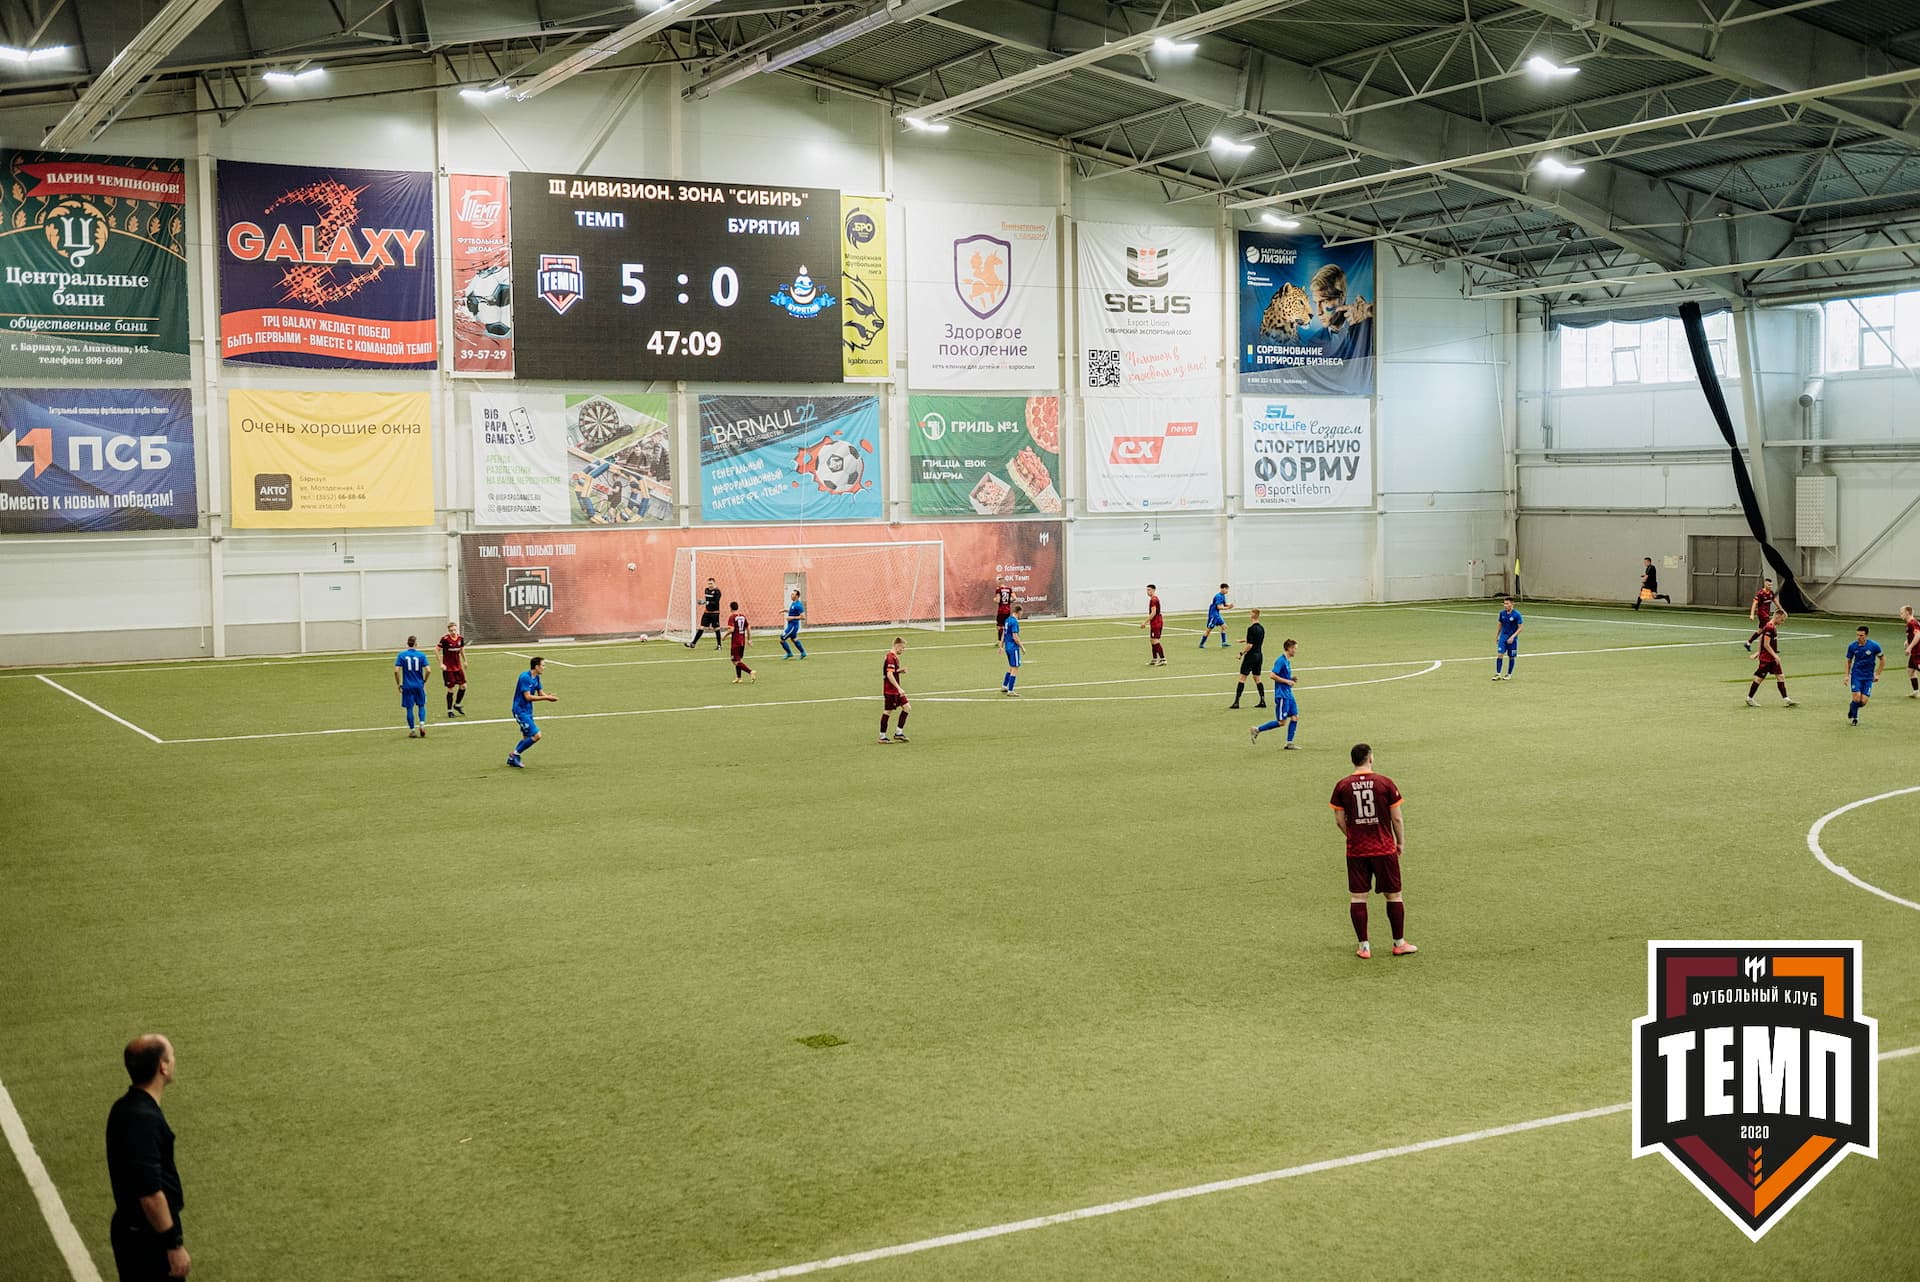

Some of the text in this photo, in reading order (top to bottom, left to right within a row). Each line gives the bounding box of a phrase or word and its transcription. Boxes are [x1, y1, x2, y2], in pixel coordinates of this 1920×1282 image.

[46, 172, 180, 194] ПАРИМ ЧЕМПИОНОВ!
[570, 180, 674, 200] ДИВИЗИОН.
[678, 186, 725, 203] ЗОНА
[729, 189, 809, 207] "СИБИРЬ"
[574, 210, 624, 228] ТЕМП
[727, 217, 801, 236] БУРЯТИЯ
[227, 221, 425, 267] GALAXY
[1260, 255, 1297, 264] ЛИЗИНГ
[6, 266, 149, 290] Центральные
[542, 271, 579, 293] ТЕМП
[621, 263, 646, 305] 5
[711, 265, 740, 307] 0
[52, 288, 105, 307] бани
[1105, 294, 1191, 313] SEUS
[9, 318, 148, 332] общественные бани
[262, 315, 391, 339] ТРЦ GALAXY ЖЕЛАЕТ ПОБЕД!
[1128, 318, 1170, 327] Export Union
[945, 323, 1022, 341] Здоровое
[20, 342, 64, 354] Барнаул,
[66, 344, 80, 353] ул.
[227, 333, 253, 348] БЫТЬ
[255, 333, 301, 345] ПЕРВЫМИ
[309, 335, 345, 350] ВМЕСТЕ
[346, 338, 353, 350] С
[354, 341, 404, 355] КОМАНДОЙ
[646, 331, 722, 357] 47:09
[939, 343, 1028, 357] поколение
[1257, 345, 1323, 355] СОРЕВНОВАНИЕ
[39, 355, 84, 366] телефон:
[460, 350, 507, 360] 39-57-29
[1265, 356, 1305, 366] ПРИРОДЕ
[1306, 357, 1344, 366] БИЗНЕСА
[484, 409, 499, 419] BIG
[241, 418, 421, 437] Очень хорошие окна
[485, 421, 507, 432] PAPA
[951, 421, 1019, 432] ГРИЛЬ №1
[1171, 425, 1193, 433] news
[1254, 420, 1306, 432] SportLife
[1310, 420, 1364, 439] Создаем
[485, 433, 515, 445] GAMES
[1255, 440, 1360, 453] СПОРТИВНУЮ
[69, 435, 172, 471] ПСБ
[712, 458, 764, 480] ГЕНЕРАЛЬНЫЙ
[923, 472, 963, 480] ШАУРМА
[1255, 456, 1360, 481] ФОРМУ
[712, 468, 783, 496] ИНФОРМАЦИОННЫЙ
[260, 486, 287, 495] АКТО
[1268, 484, 1331, 497] sportlifebrn
[0, 489, 174, 511] Вместе к новым победам!
[1144, 523, 1149, 532] 2
[332, 542, 337, 552] 1
[478, 546, 500, 558] ТЕМП,
[503, 545, 525, 557] ТЕМП,
[525, 544, 553, 556] ТОЛЬКО
[509, 585, 549, 607] ТЕМП
[405, 656, 420, 671] 11
[1353, 789, 1376, 818] 13
